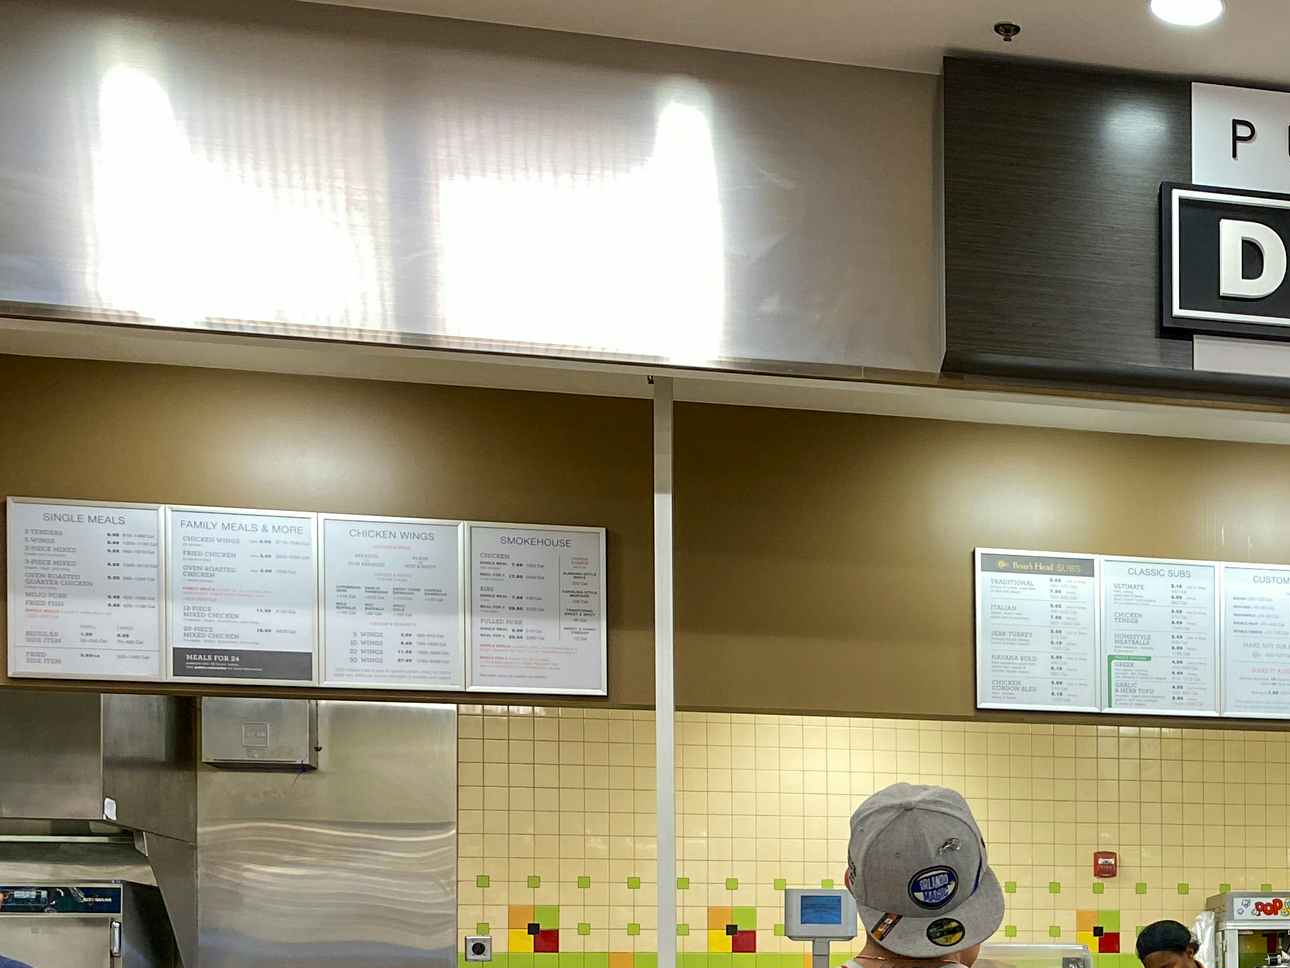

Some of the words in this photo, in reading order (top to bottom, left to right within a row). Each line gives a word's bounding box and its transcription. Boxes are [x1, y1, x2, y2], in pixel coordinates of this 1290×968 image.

[42, 512, 84, 523] SINGLE
[87, 514, 126, 526] MEALS
[180, 519, 218, 530] FAMILY
[221, 522, 258, 532] MEALS
[261, 525, 269, 533] &
[272, 525, 304, 536] MORE
[348, 528, 396, 539] CHICKEN
[399, 531, 435, 541] WINGS
[499, 536, 573, 548] SMOKEHOUSE
[1127, 567, 1166, 577] CLASSIC
[1167, 569, 1191, 578] SUBS
